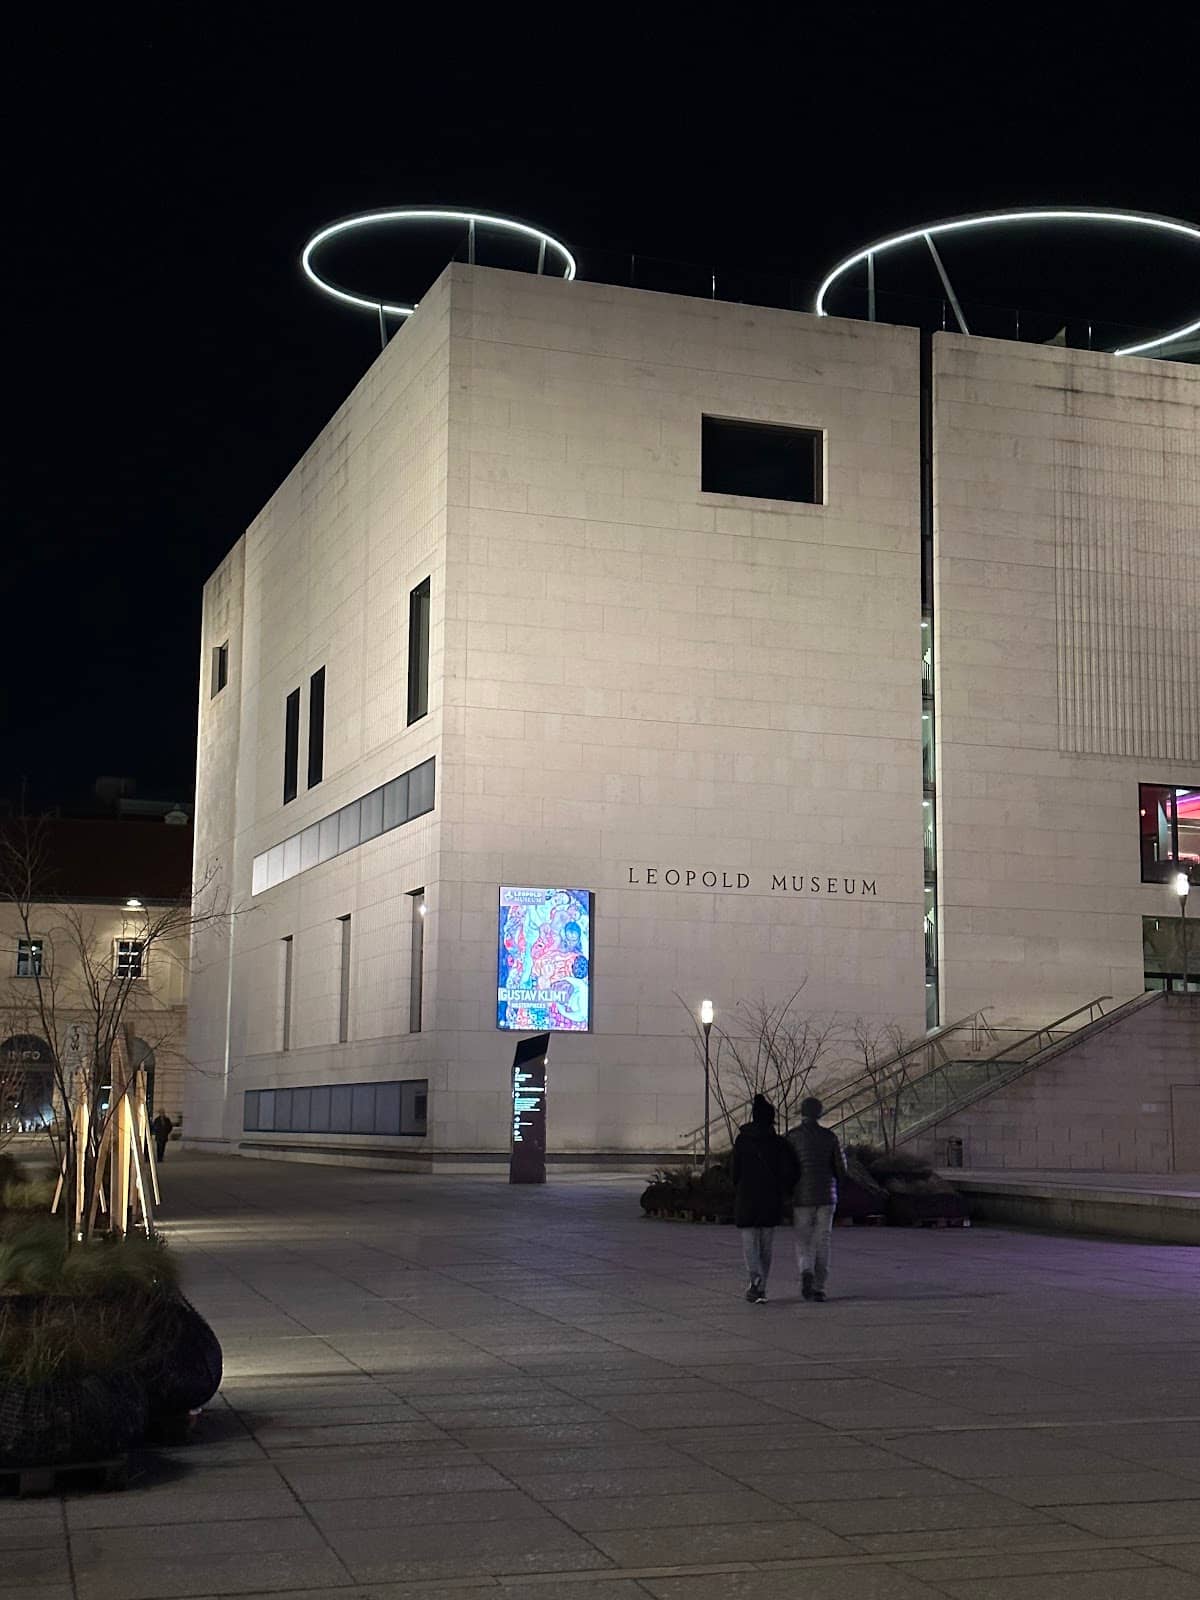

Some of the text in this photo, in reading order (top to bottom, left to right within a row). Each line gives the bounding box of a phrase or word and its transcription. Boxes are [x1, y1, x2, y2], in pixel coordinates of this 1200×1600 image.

[628, 867, 878, 896] LEOPOLD MUSEUM
[501, 989, 567, 1002] GUSTAV KLIMT
[8, 1050, 41, 1060] INFO
